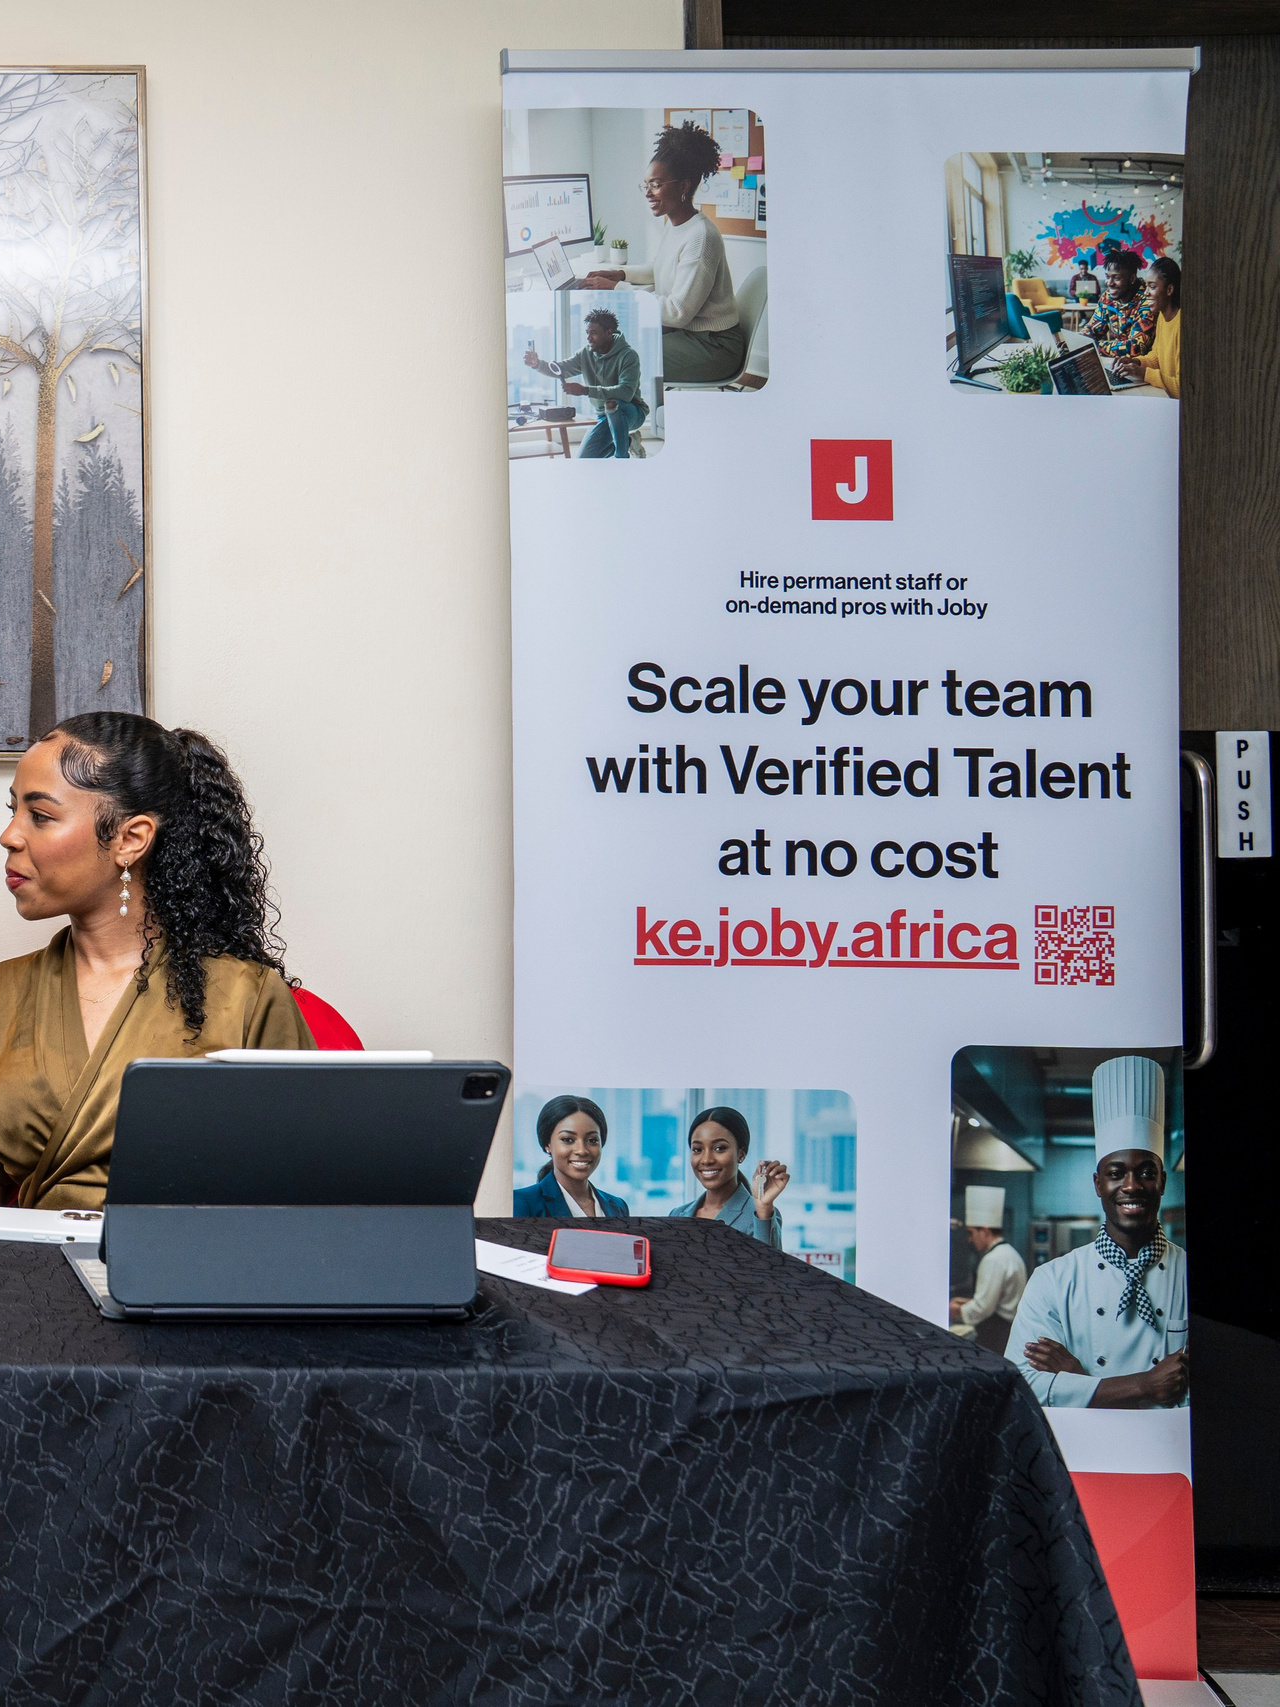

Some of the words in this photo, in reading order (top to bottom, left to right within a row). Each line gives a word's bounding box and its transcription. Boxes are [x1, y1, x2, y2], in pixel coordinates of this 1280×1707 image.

[836, 456, 868, 504] J
[725, 596, 837, 615] on-demand
[841, 601, 887, 619] pros
[890, 597, 933, 616] with
[937, 598, 989, 620] Joby
[740, 570, 779, 589] Hire
[783, 573, 892, 593] permanent
[895, 572, 943, 591] staff
[946, 577, 968, 591] or
[627, 662, 786, 715] Scale
[798, 678, 929, 726] your
[941, 669, 1092, 718] team
[585, 743, 707, 794] with
[719, 744, 939, 798] Verified
[953, 747, 1132, 800] Talent
[1236, 739, 1254, 851] PUSH
[718, 829, 772, 876] at
[785, 839, 858, 878] no
[871, 831, 999, 879] cost
[633, 905, 1020, 969] ke.joby.africa
